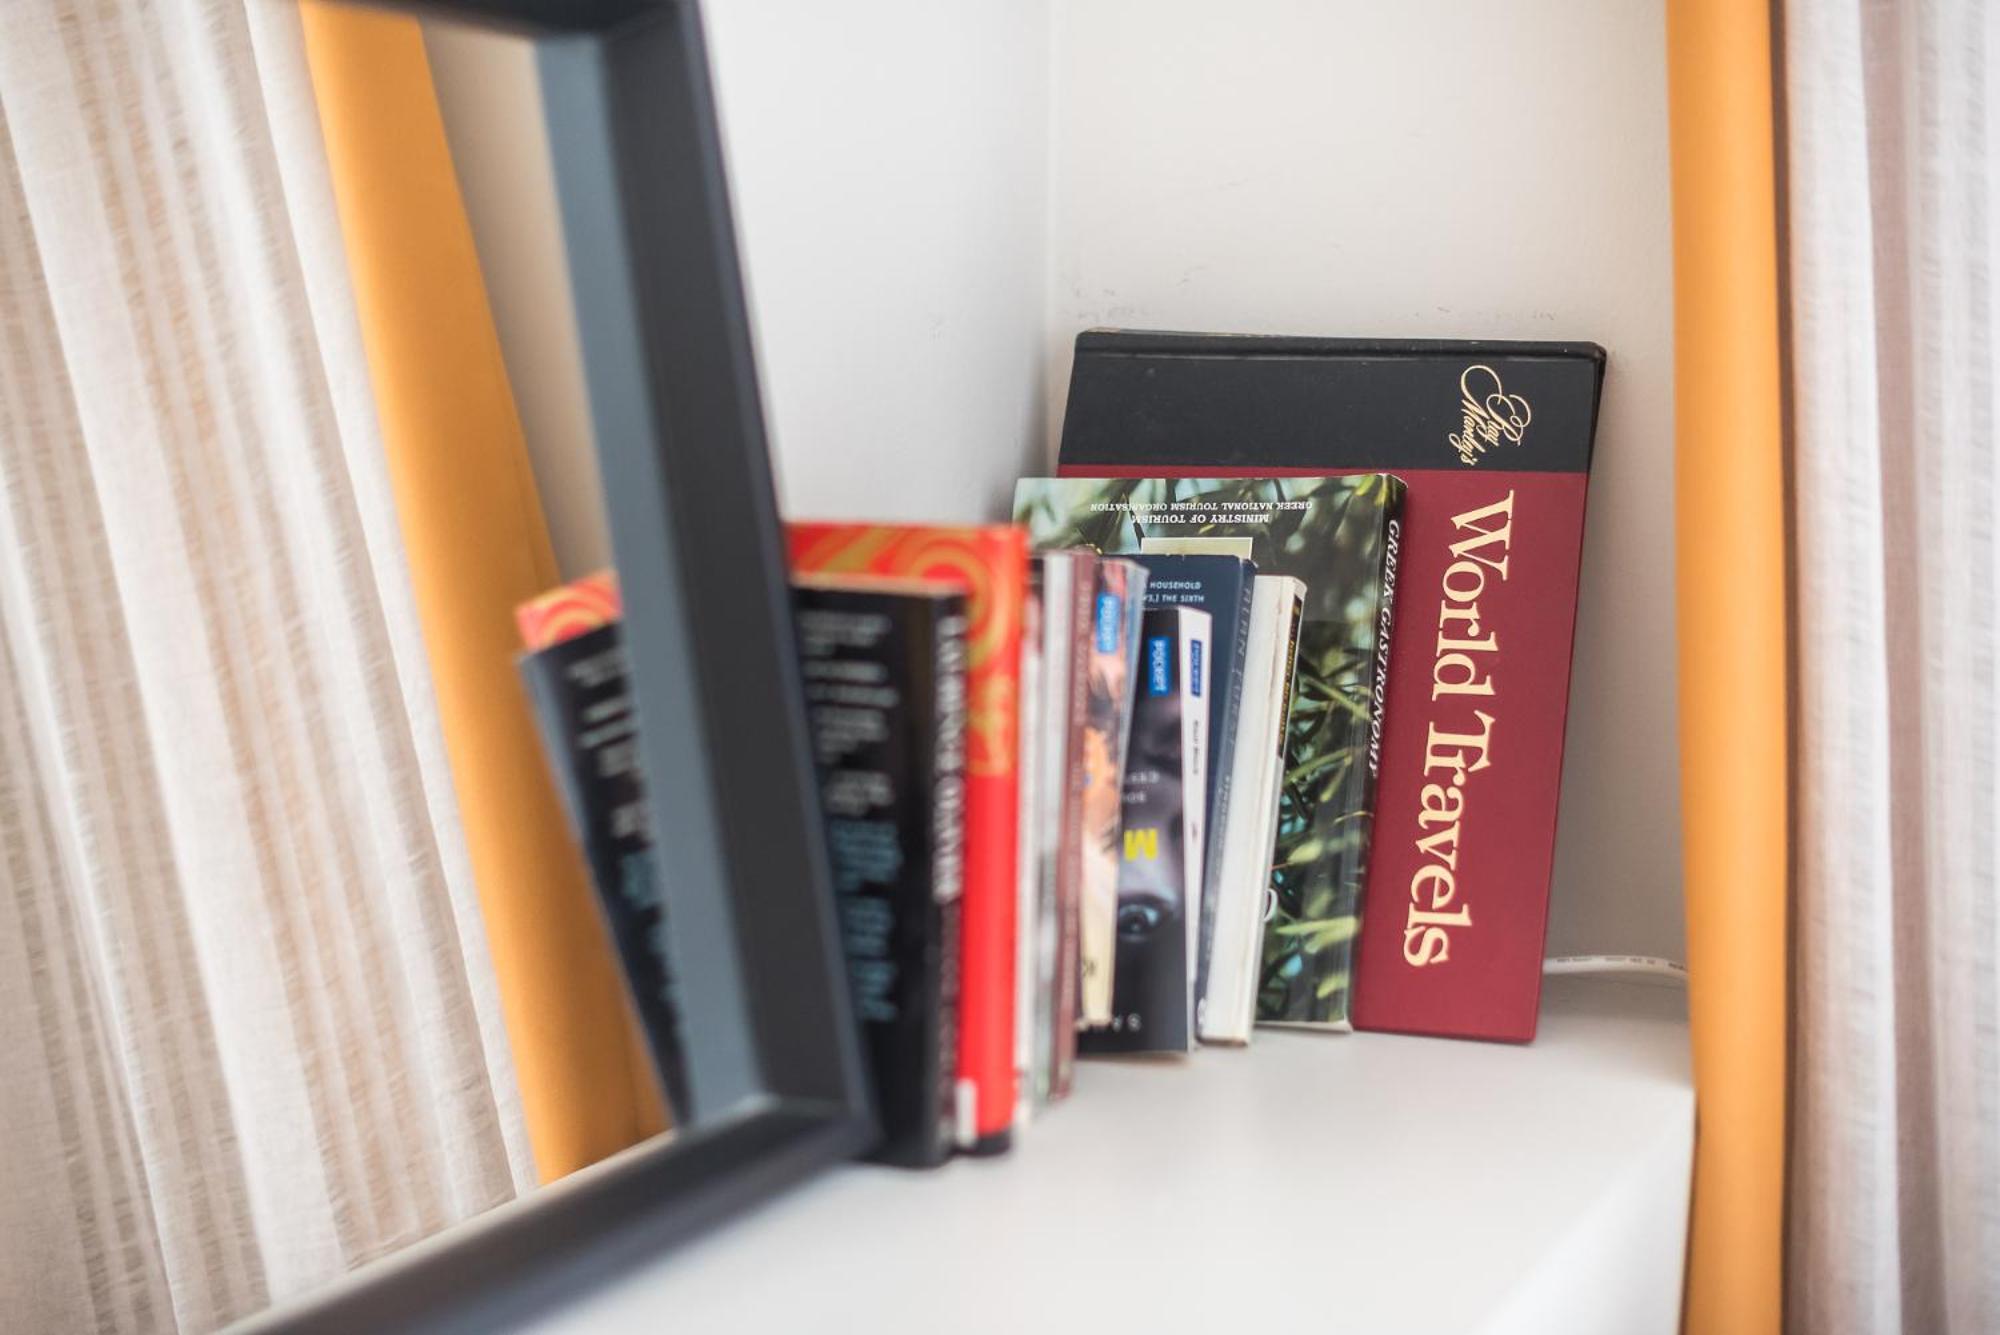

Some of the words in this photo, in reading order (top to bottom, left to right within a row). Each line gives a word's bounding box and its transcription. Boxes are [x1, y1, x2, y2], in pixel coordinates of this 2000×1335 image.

[1089, 502, 1168, 512] ORGANISATION
[1169, 502, 1218, 512] TOURISM
[1220, 501, 1274, 511] NATIONAL
[1276, 501, 1313, 510] GREEK
[1131, 514, 1186, 524] TOURISM
[1188, 514, 1207, 523] OF
[1208, 513, 1269, 523] MINISTRY
[1382, 519, 1401, 604] GREEK
[1149, 581, 1202, 590] HOUSEHOLD
[1161, 594, 1178, 602] THE
[1180, 594, 1205, 603] SIXTH
[1430, 490, 1514, 705] World
[1367, 606, 1392, 780] GASTRONOMY
[1402, 714, 1495, 968] Travels
